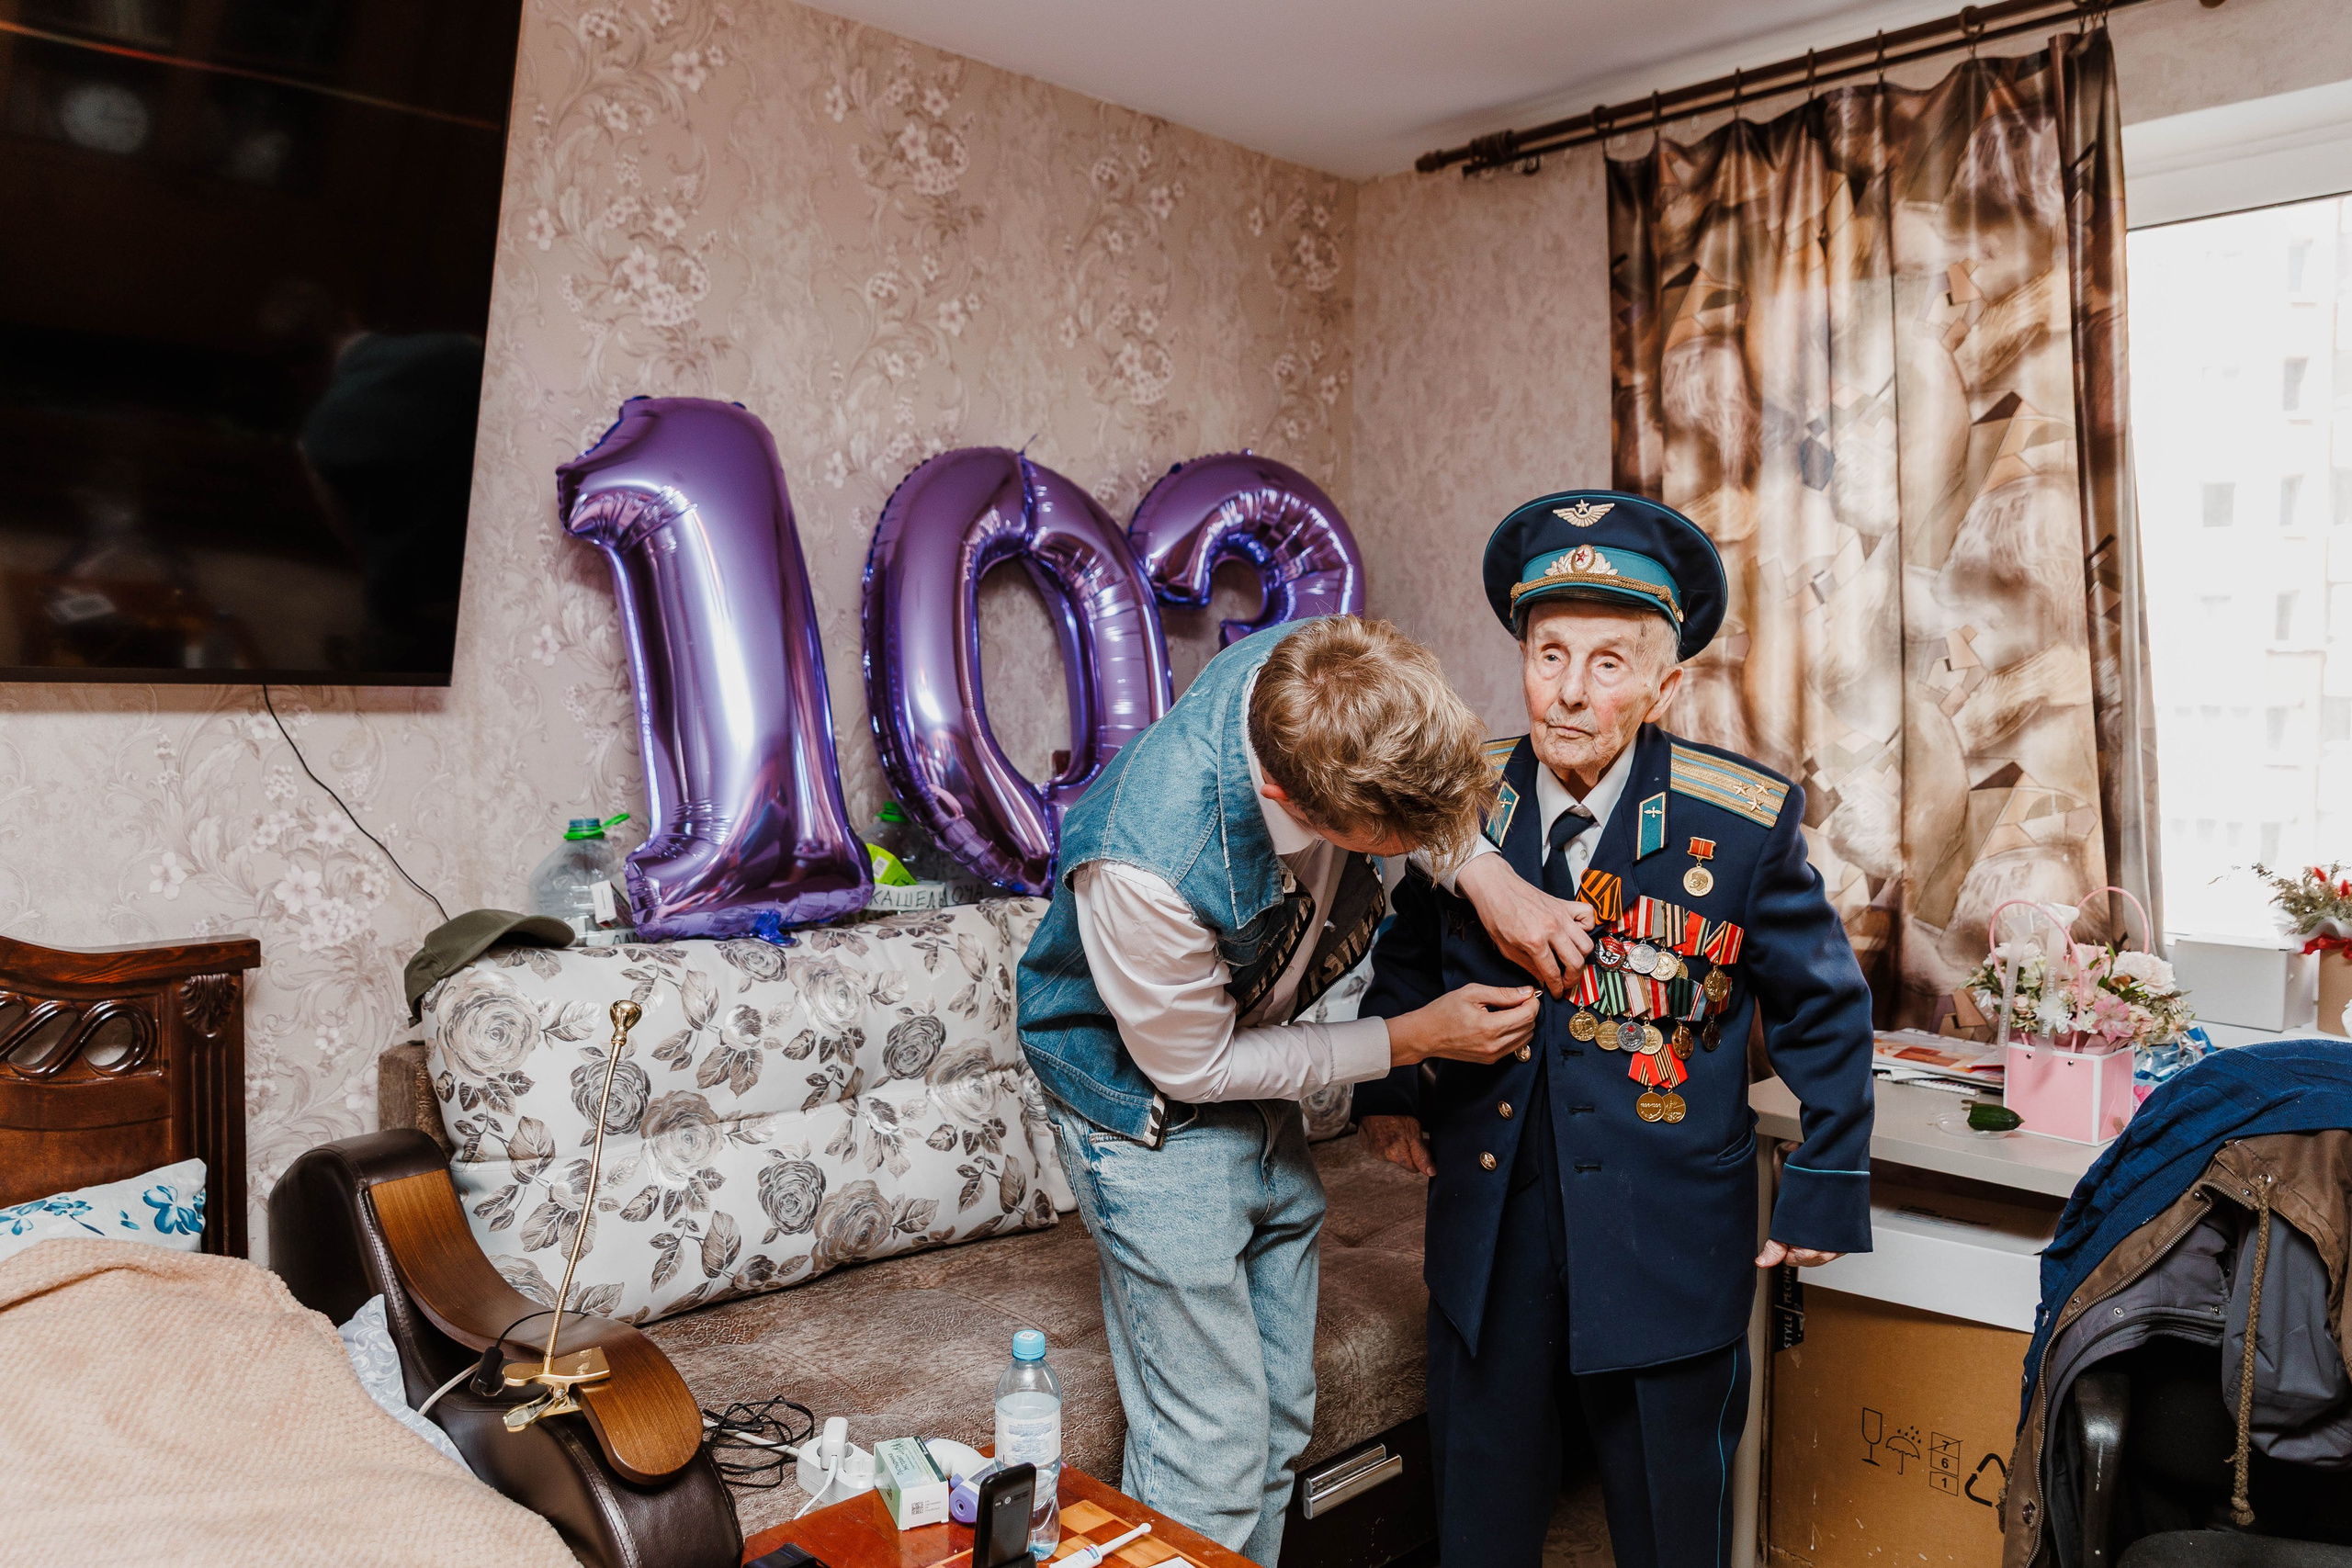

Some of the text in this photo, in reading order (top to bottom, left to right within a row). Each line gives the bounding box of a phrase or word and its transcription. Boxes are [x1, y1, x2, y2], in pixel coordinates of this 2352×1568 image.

[1783, 1314, 1793, 1349] STYLE
[1941, 1439, 1951, 1451] 7
[1940, 1457, 1950, 1470] 6
[1940, 1476, 1948, 1489] 1
